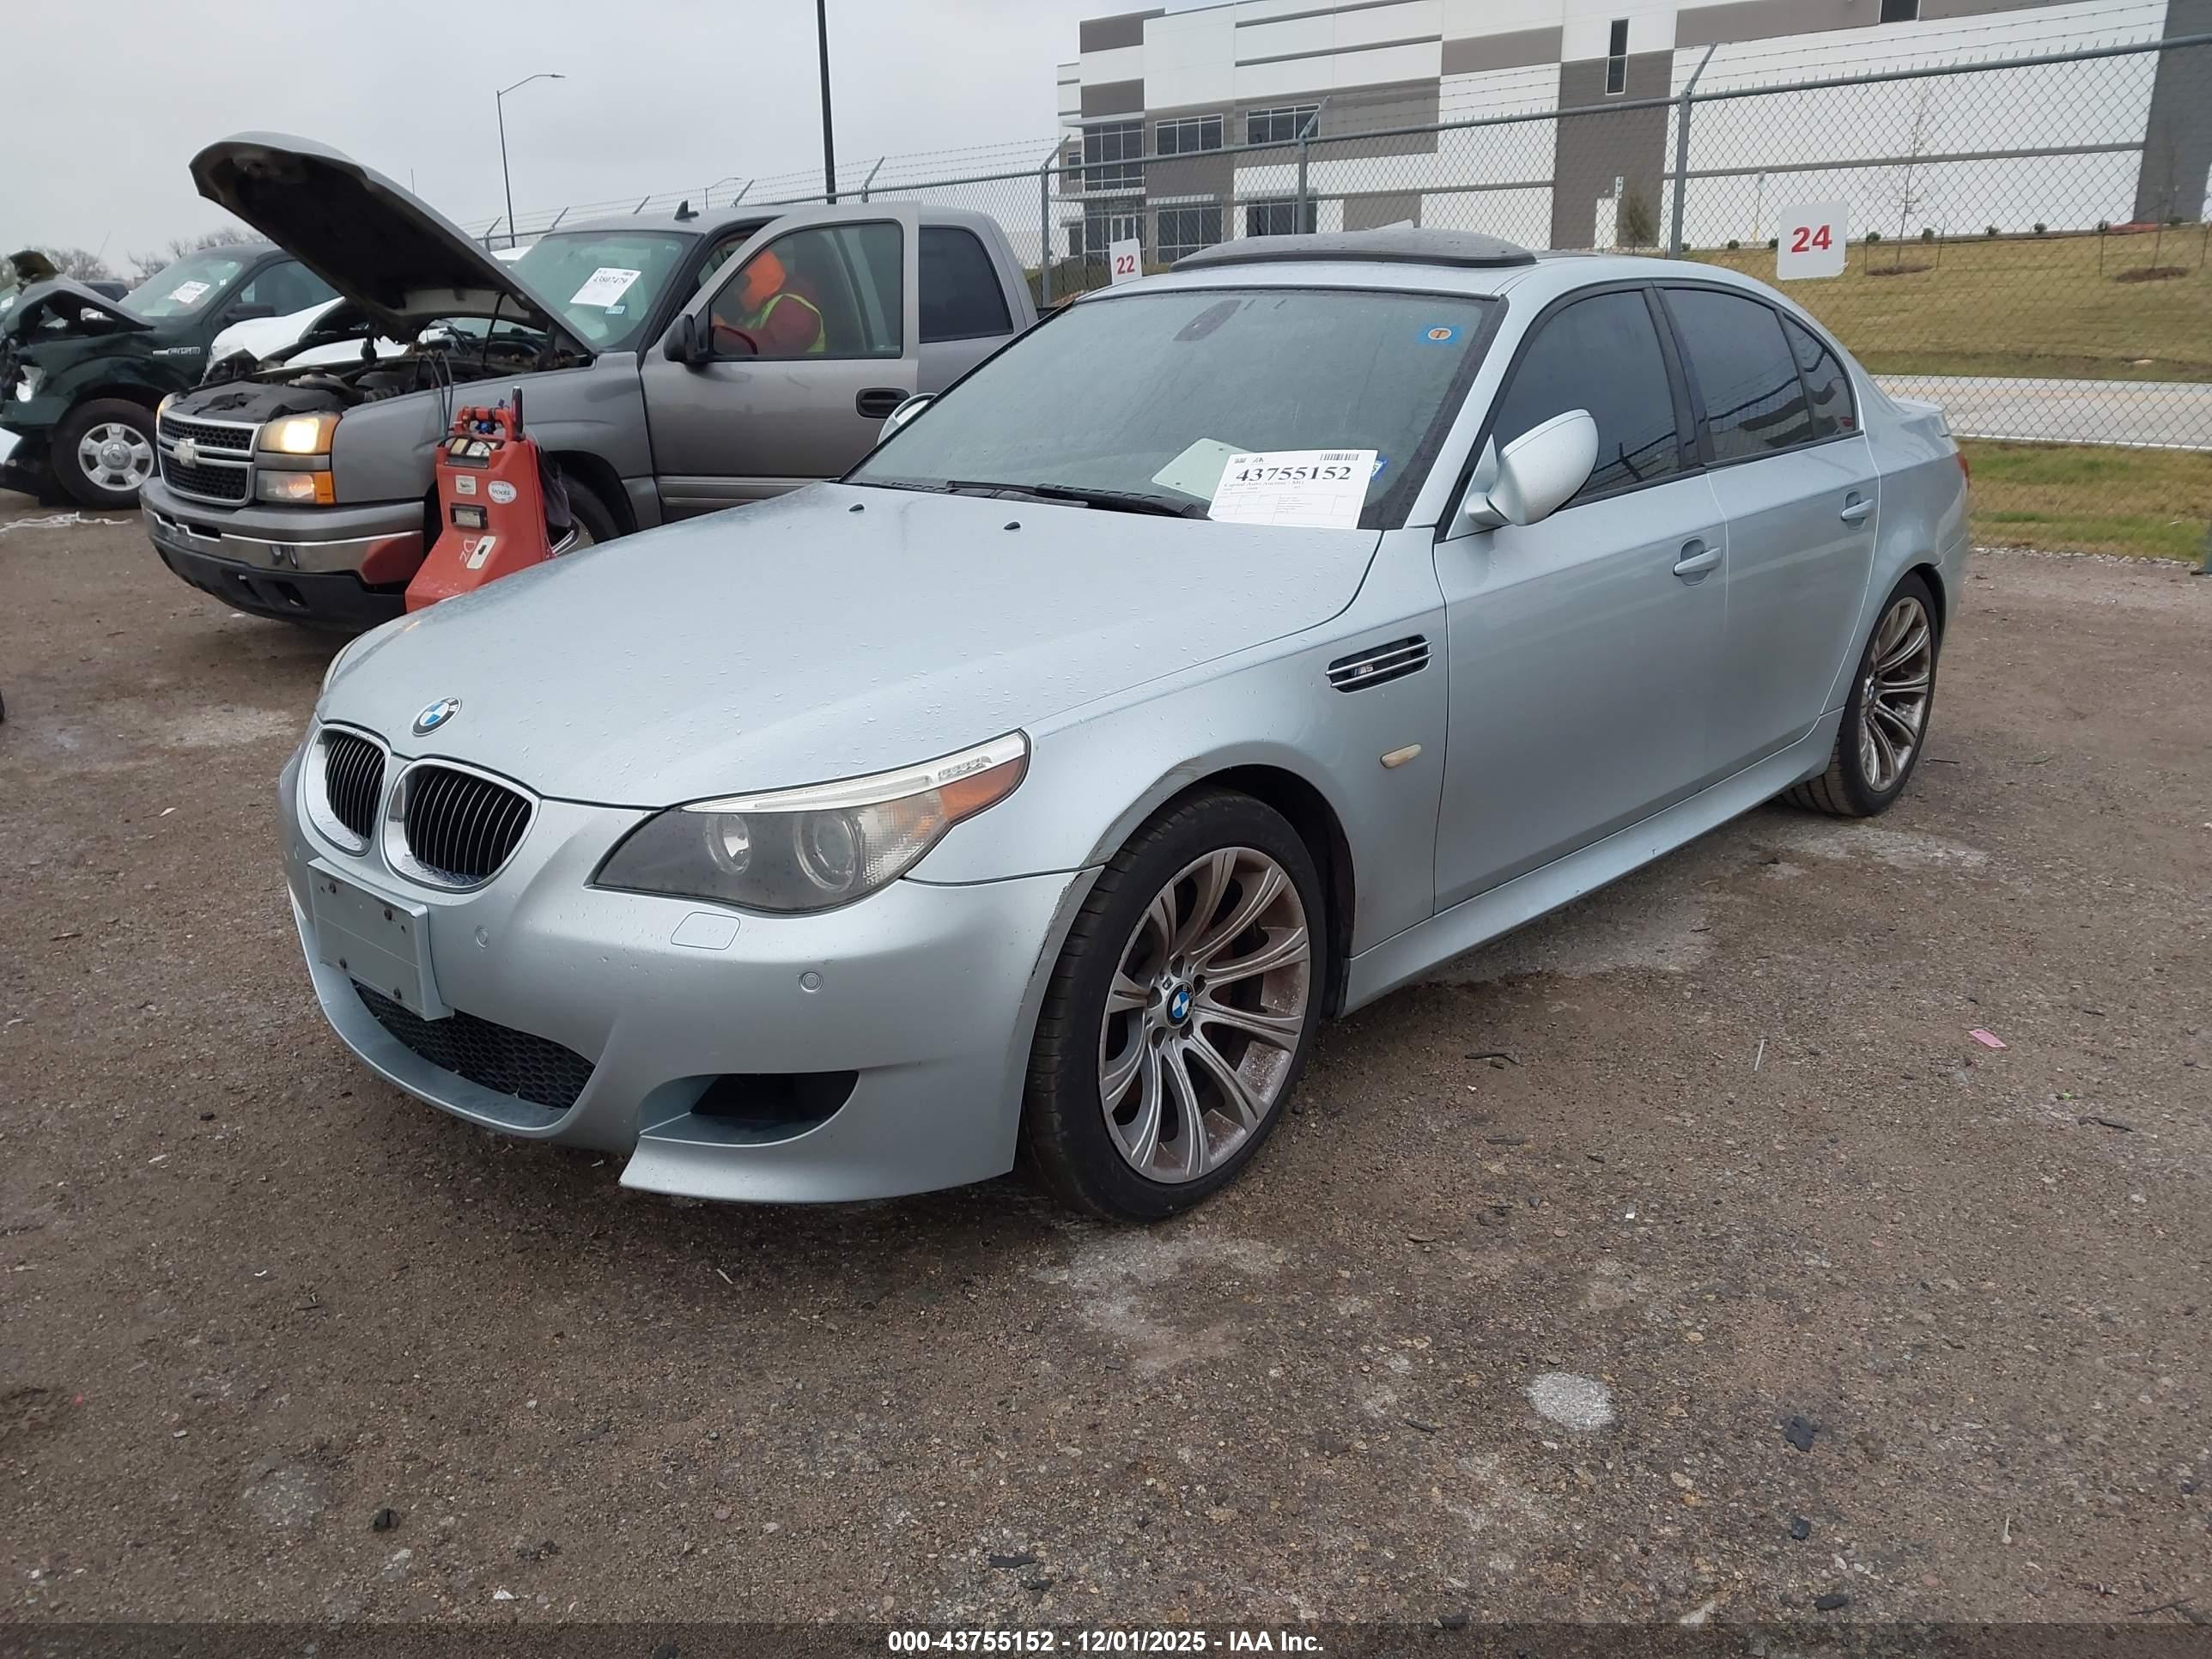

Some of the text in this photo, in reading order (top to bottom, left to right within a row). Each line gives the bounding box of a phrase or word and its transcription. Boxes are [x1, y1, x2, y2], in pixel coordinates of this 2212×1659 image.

[1791, 224, 1832, 252] 24
[1116, 255, 1135, 275] 22
[1236, 466, 1352, 482] 43755152
